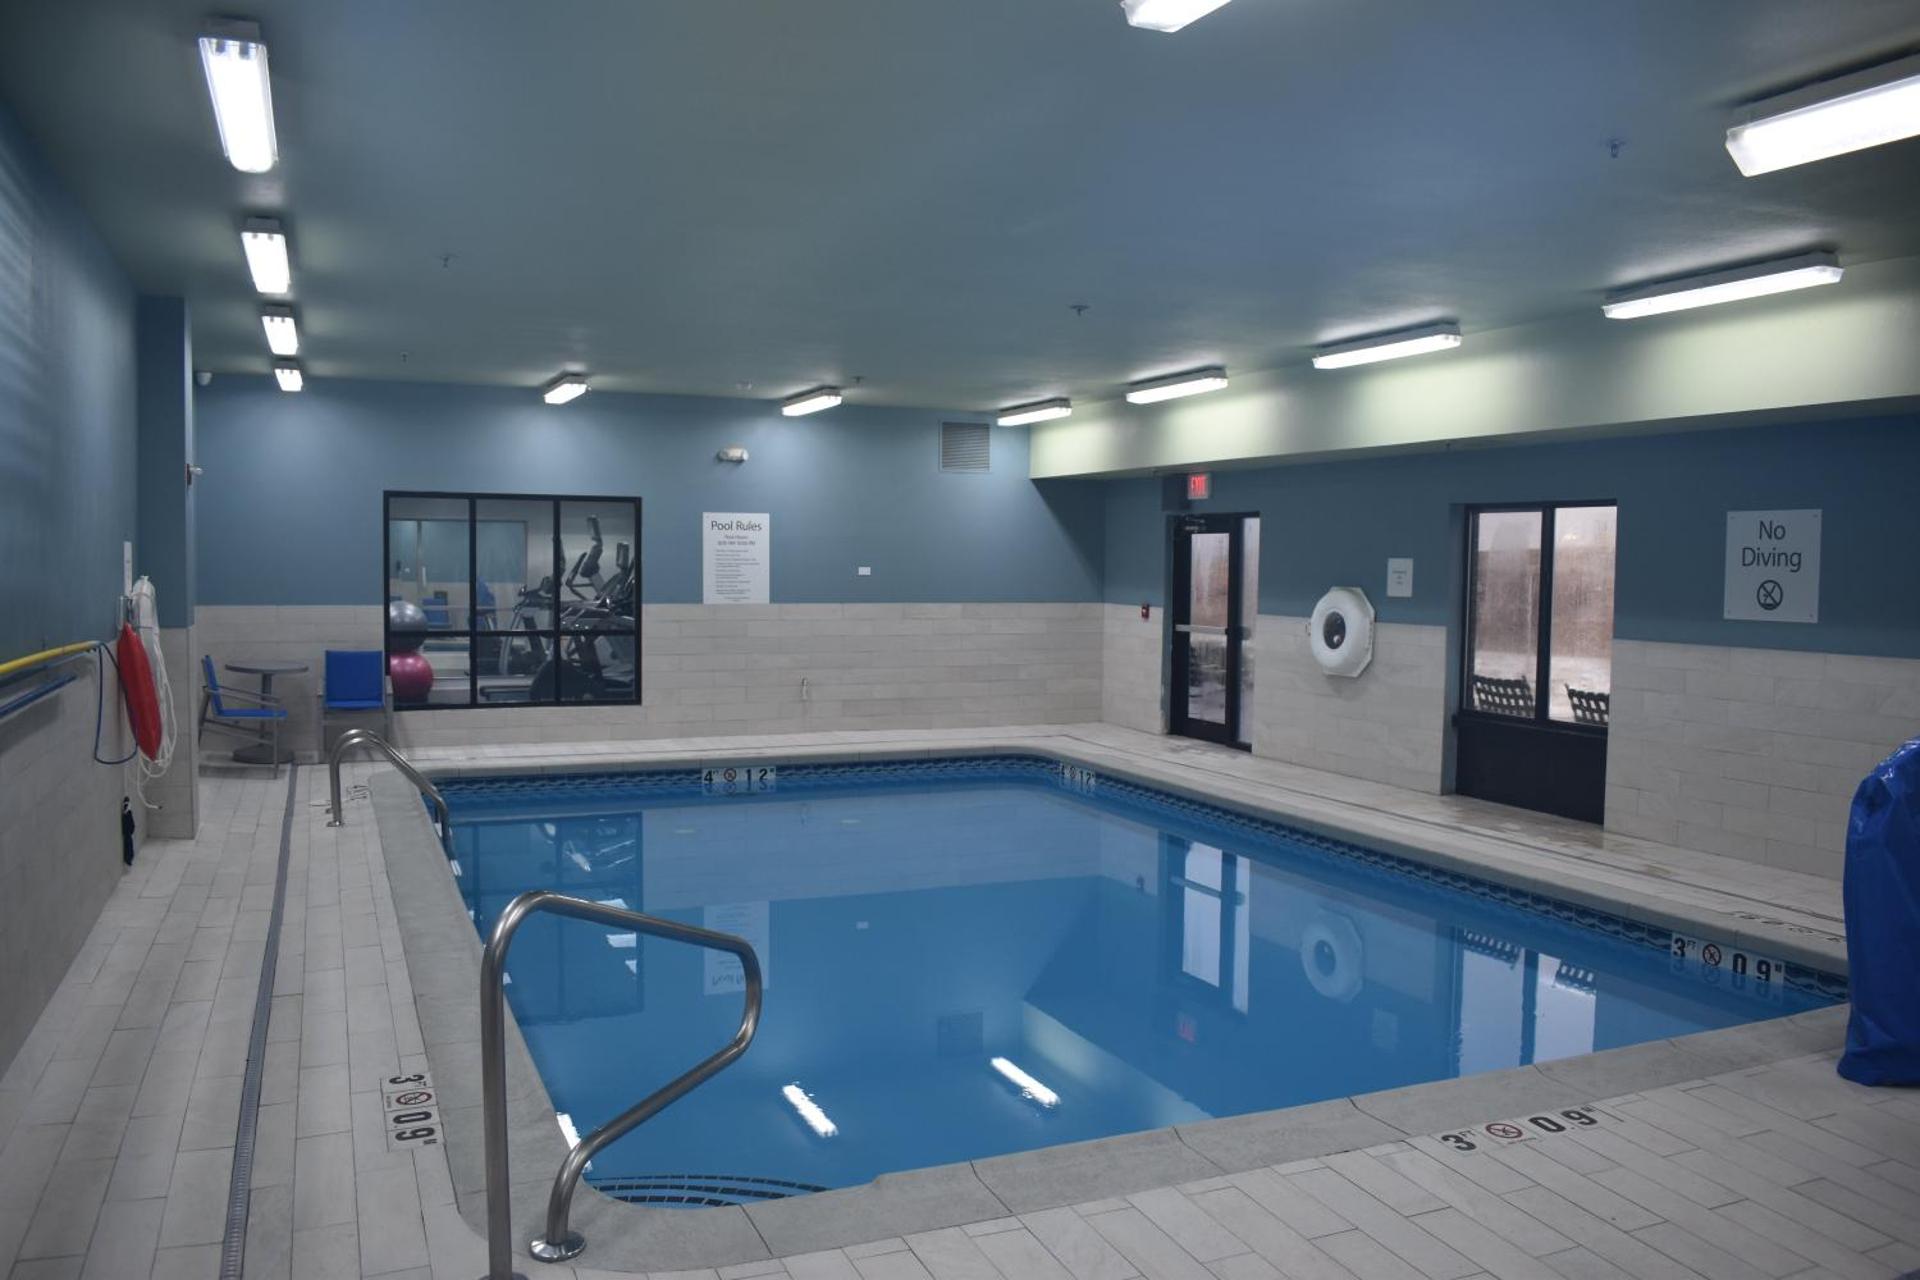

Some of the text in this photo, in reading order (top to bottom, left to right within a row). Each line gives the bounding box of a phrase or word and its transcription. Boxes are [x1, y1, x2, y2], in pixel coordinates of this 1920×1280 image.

[711, 520, 763, 531] Pool Rules
[1759, 520, 1786, 540] No
[1742, 546, 1802, 573] Diving
